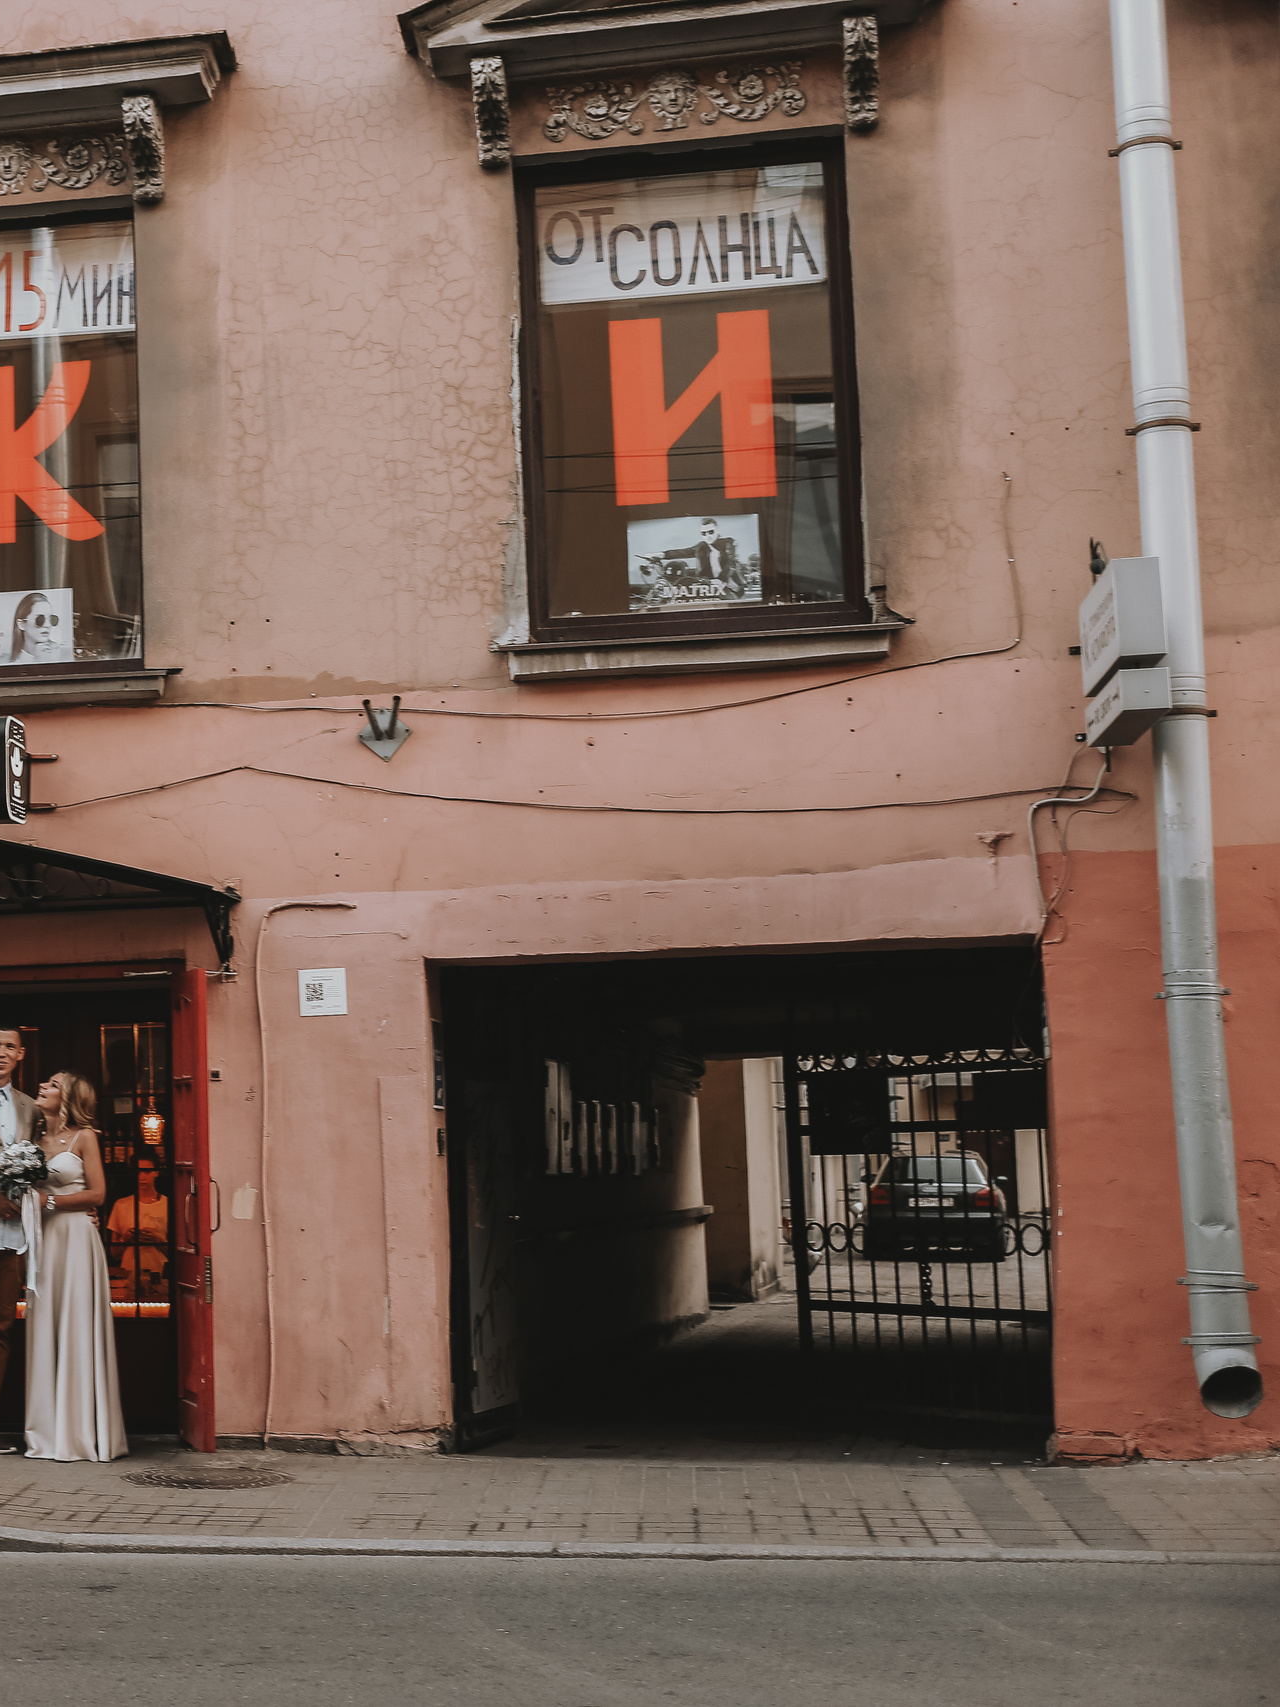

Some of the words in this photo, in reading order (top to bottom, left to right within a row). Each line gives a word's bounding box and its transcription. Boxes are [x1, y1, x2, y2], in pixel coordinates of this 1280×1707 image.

[545, 206, 614, 266] ОТ
[608, 209, 820, 291] СОЛНЦА
[662, 583, 727, 598] MATRIX
